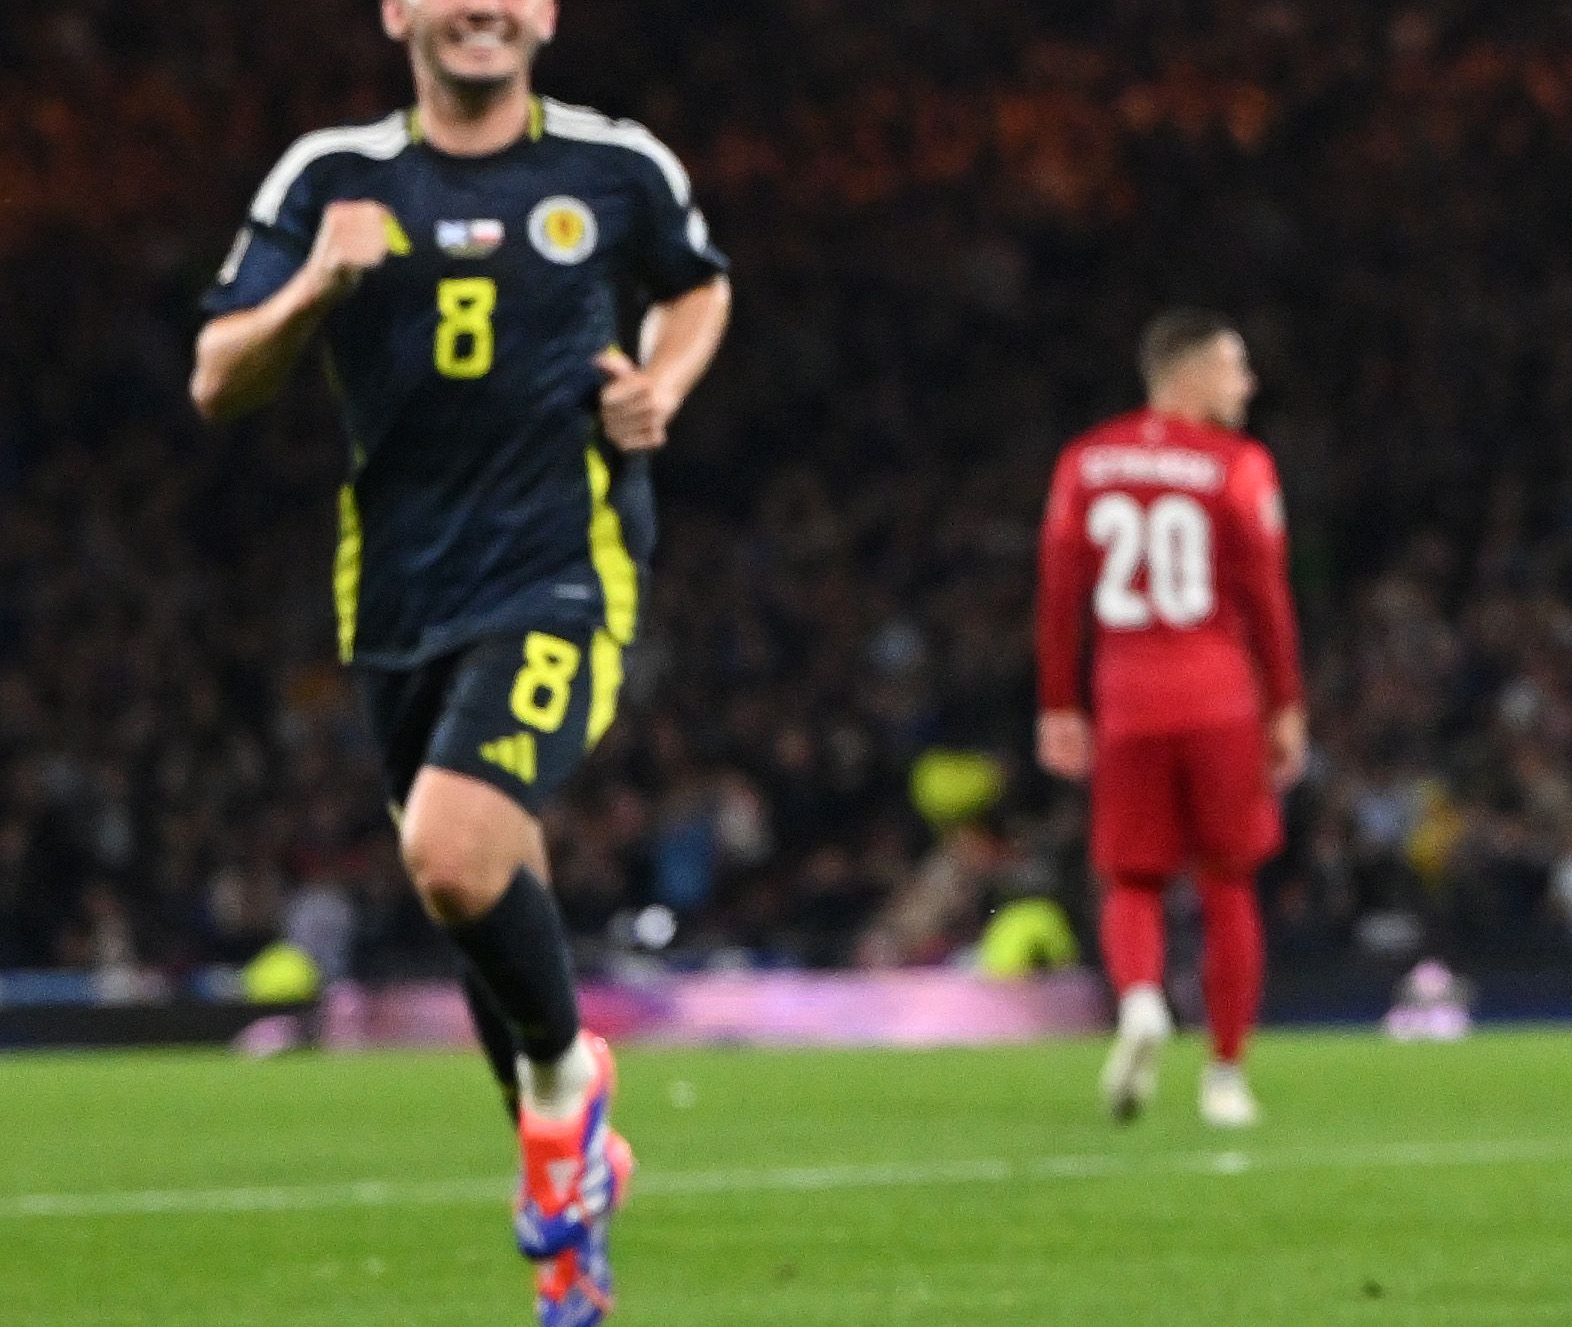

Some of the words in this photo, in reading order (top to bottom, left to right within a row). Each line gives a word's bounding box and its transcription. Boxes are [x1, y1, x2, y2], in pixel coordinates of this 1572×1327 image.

[434, 276, 498, 380] 8
[1086, 491, 1216, 631] 20
[510, 631, 581, 733] 8
